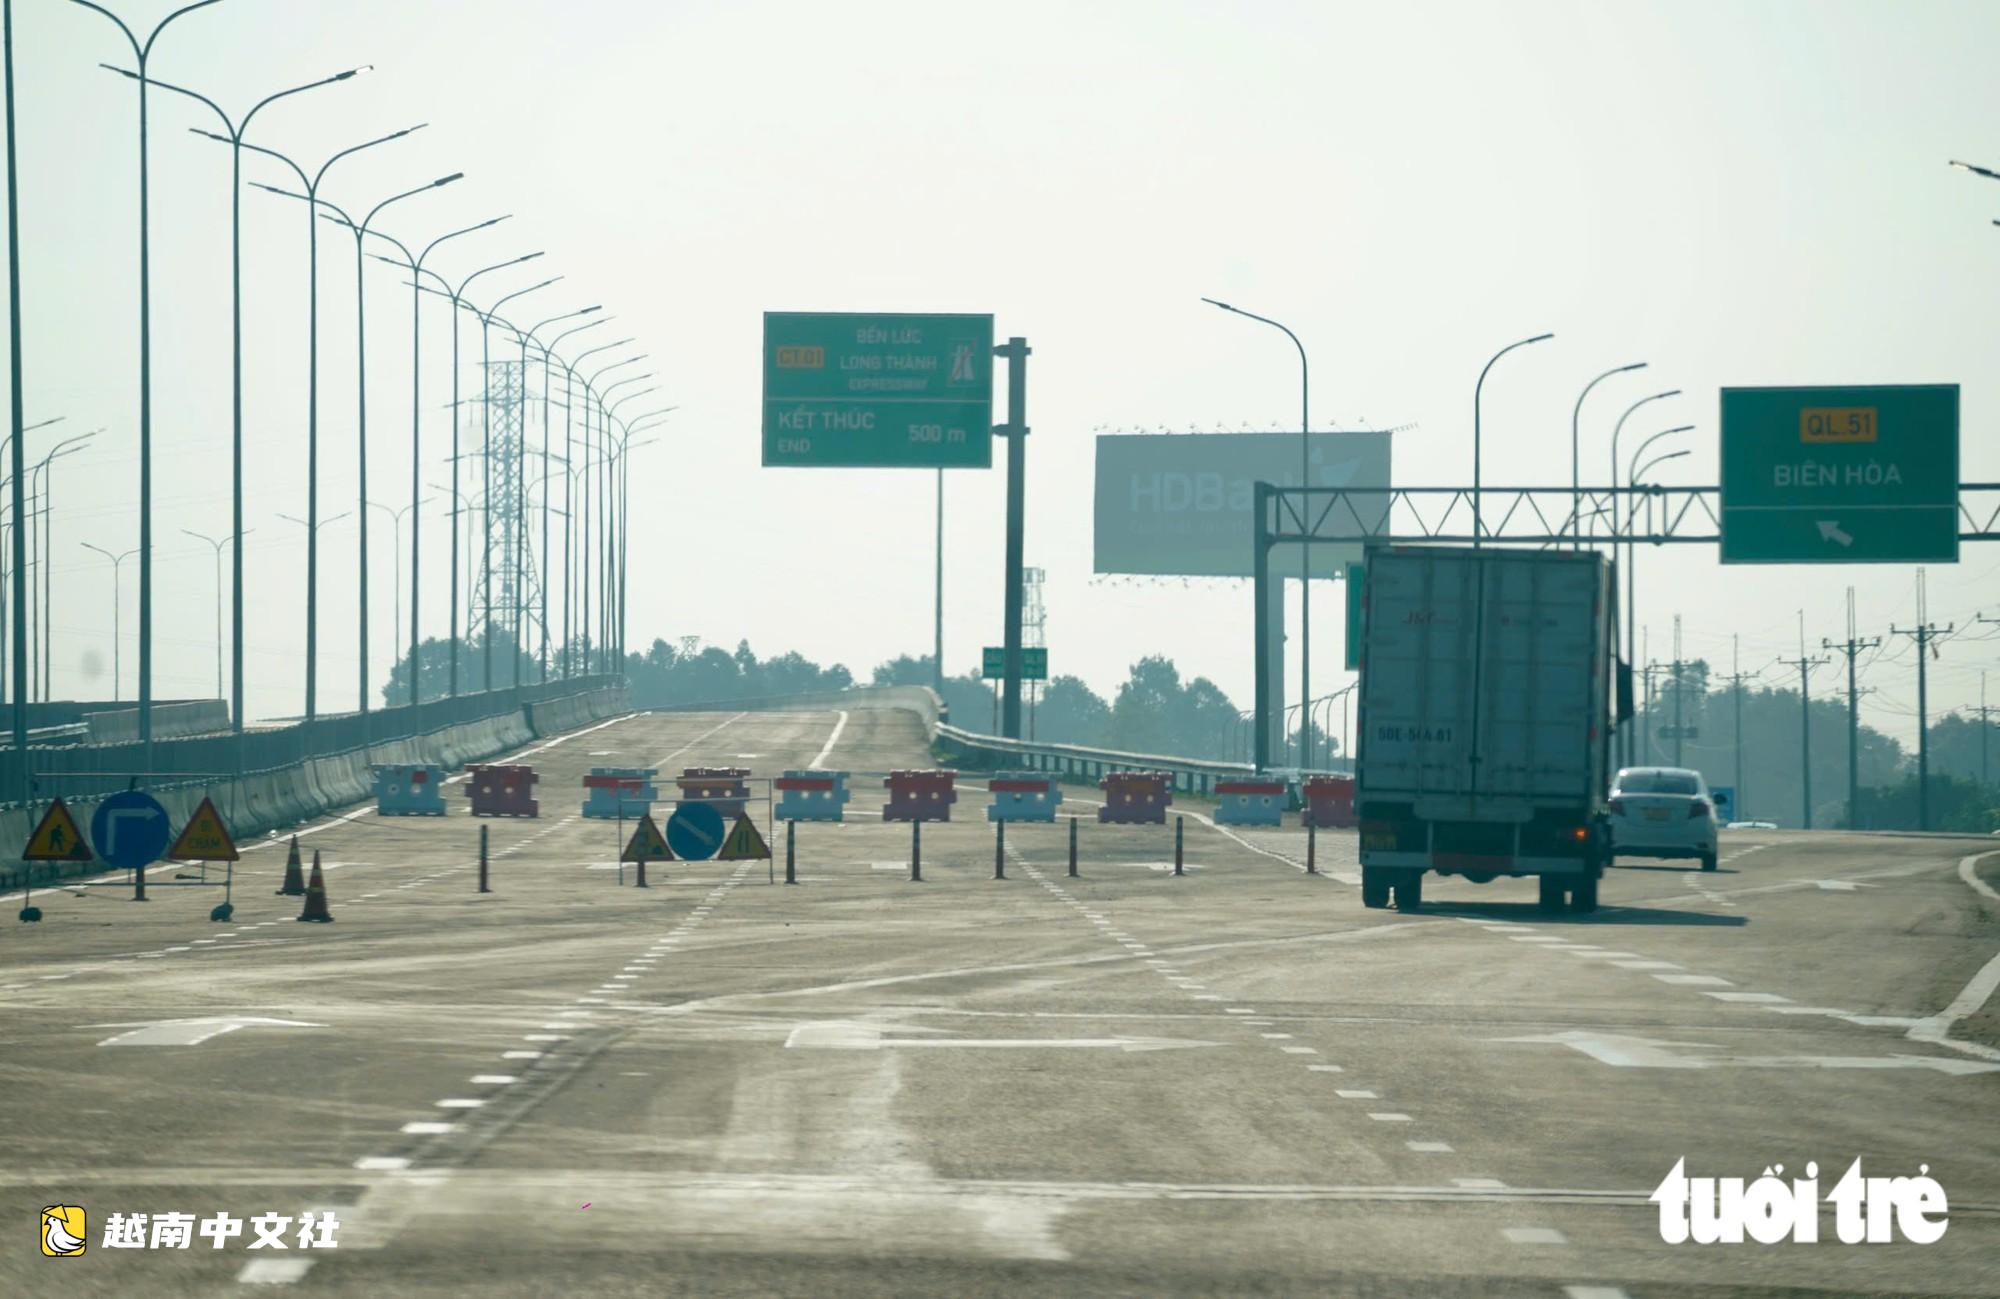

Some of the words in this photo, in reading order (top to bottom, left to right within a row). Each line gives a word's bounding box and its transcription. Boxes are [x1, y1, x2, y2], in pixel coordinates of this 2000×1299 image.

[857, 324, 888, 344] BẾN
[840, 355, 881, 370] LONG
[885, 353, 937, 370] THÀNH
[778, 406, 816, 429] KẾT
[821, 409, 875, 430] THÚC
[1806, 413, 1873, 436] QL.51
[908, 425, 941, 442] 500
[947, 429, 966, 443] m
[777, 438, 811, 453] END
[1773, 459, 1837, 487] BIÊN
[1845, 459, 1903, 485] HÒA
